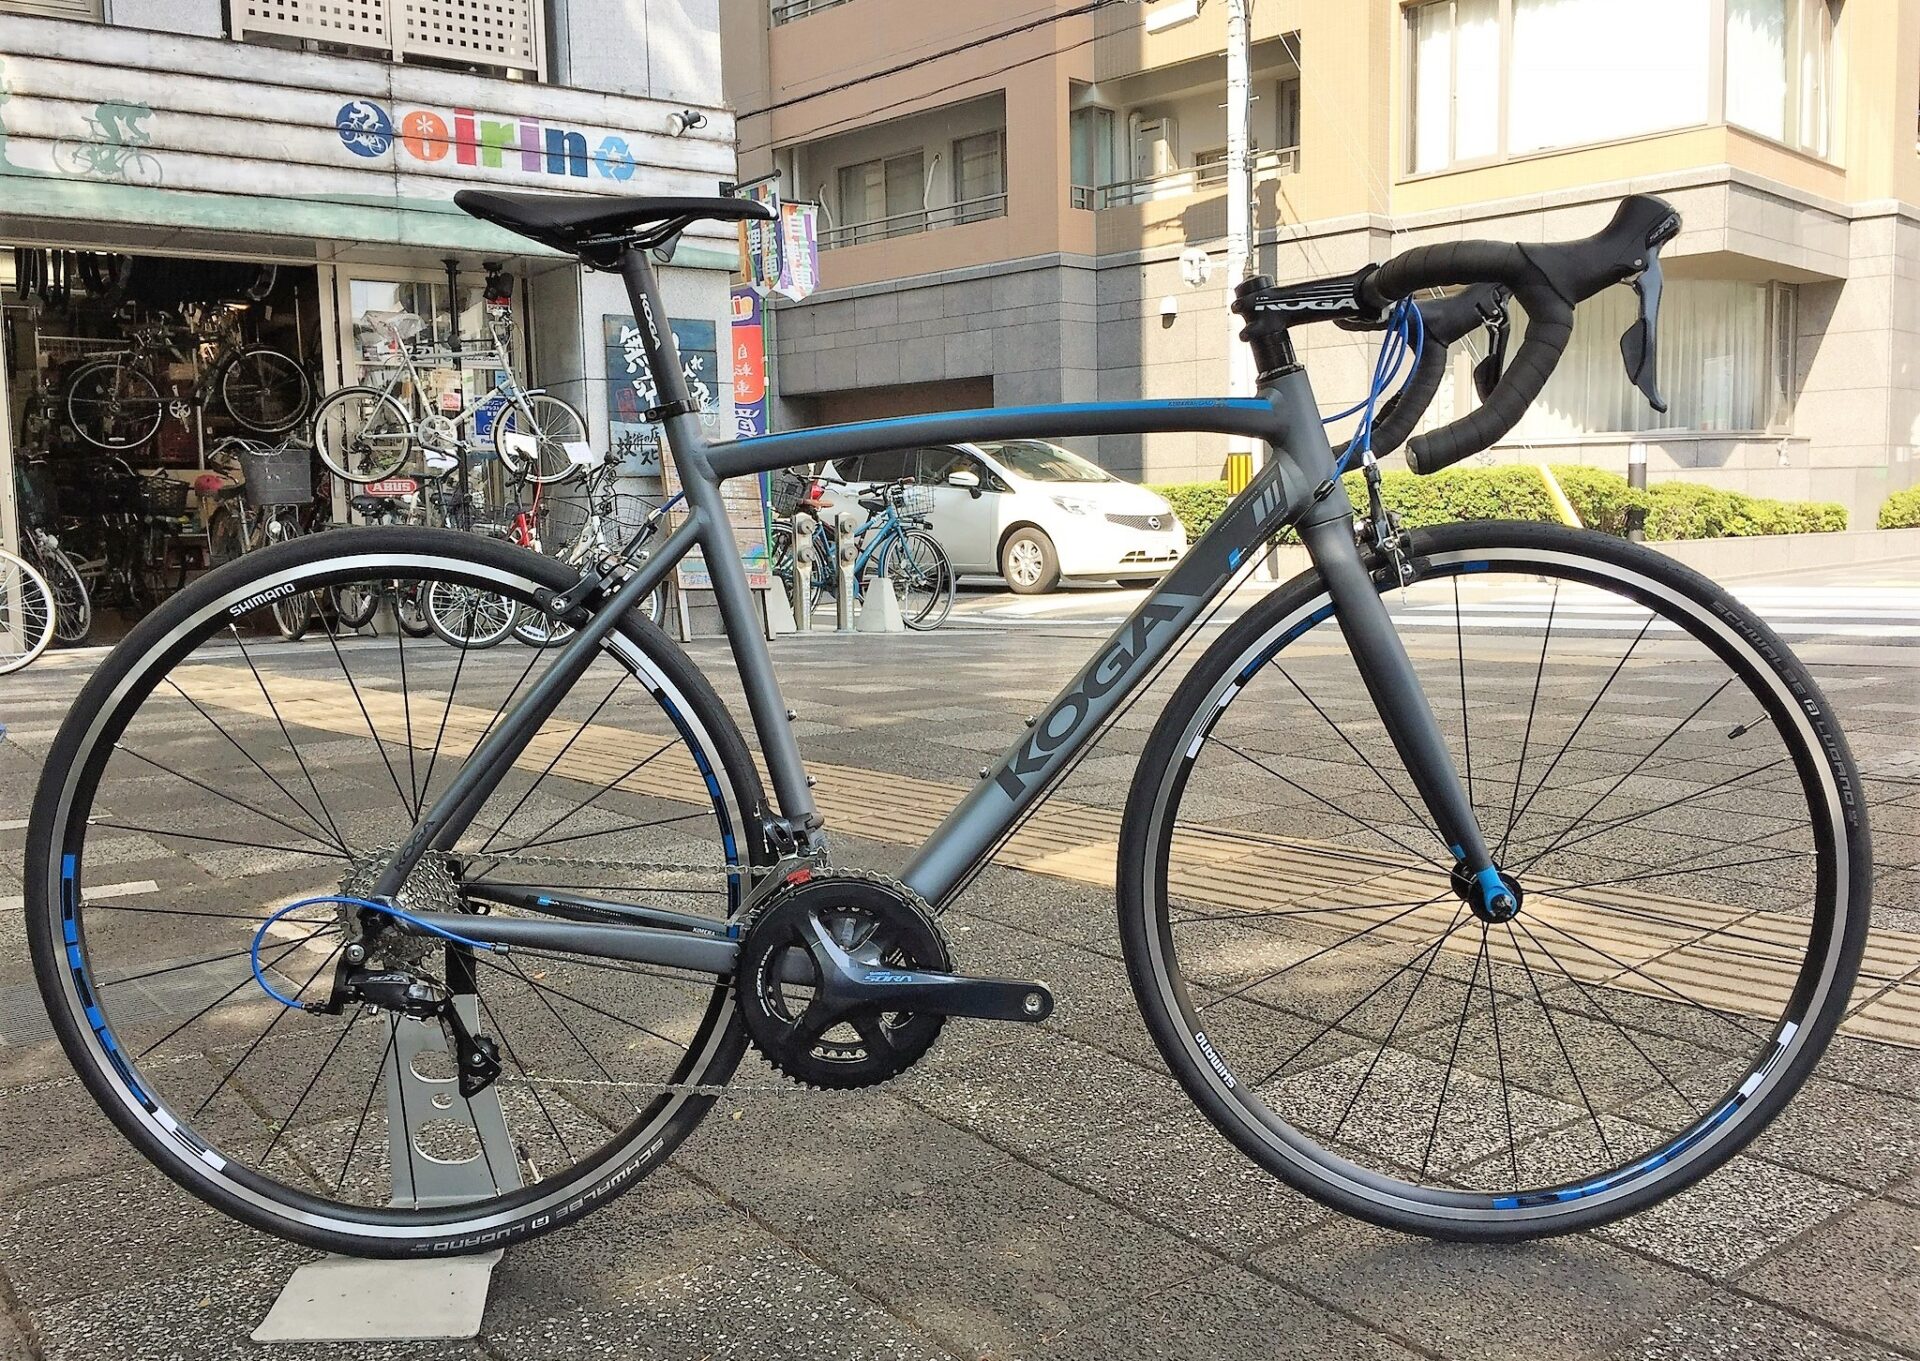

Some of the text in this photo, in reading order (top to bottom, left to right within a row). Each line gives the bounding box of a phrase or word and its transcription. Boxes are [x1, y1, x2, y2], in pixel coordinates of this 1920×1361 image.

[640, 293, 661, 351] KOGA
[372, 482, 411, 491] ABUS
[229, 583, 296, 617] SHIMANO
[995, 603, 1184, 802] KOGA
[1710, 600, 1855, 806] SCHWALBE LUGANO
[394, 820, 435, 873] KOGA
[1195, 1031, 1238, 1089] SHIMANO
[433, 1137, 665, 1251] SCHWALBE LUGANO
